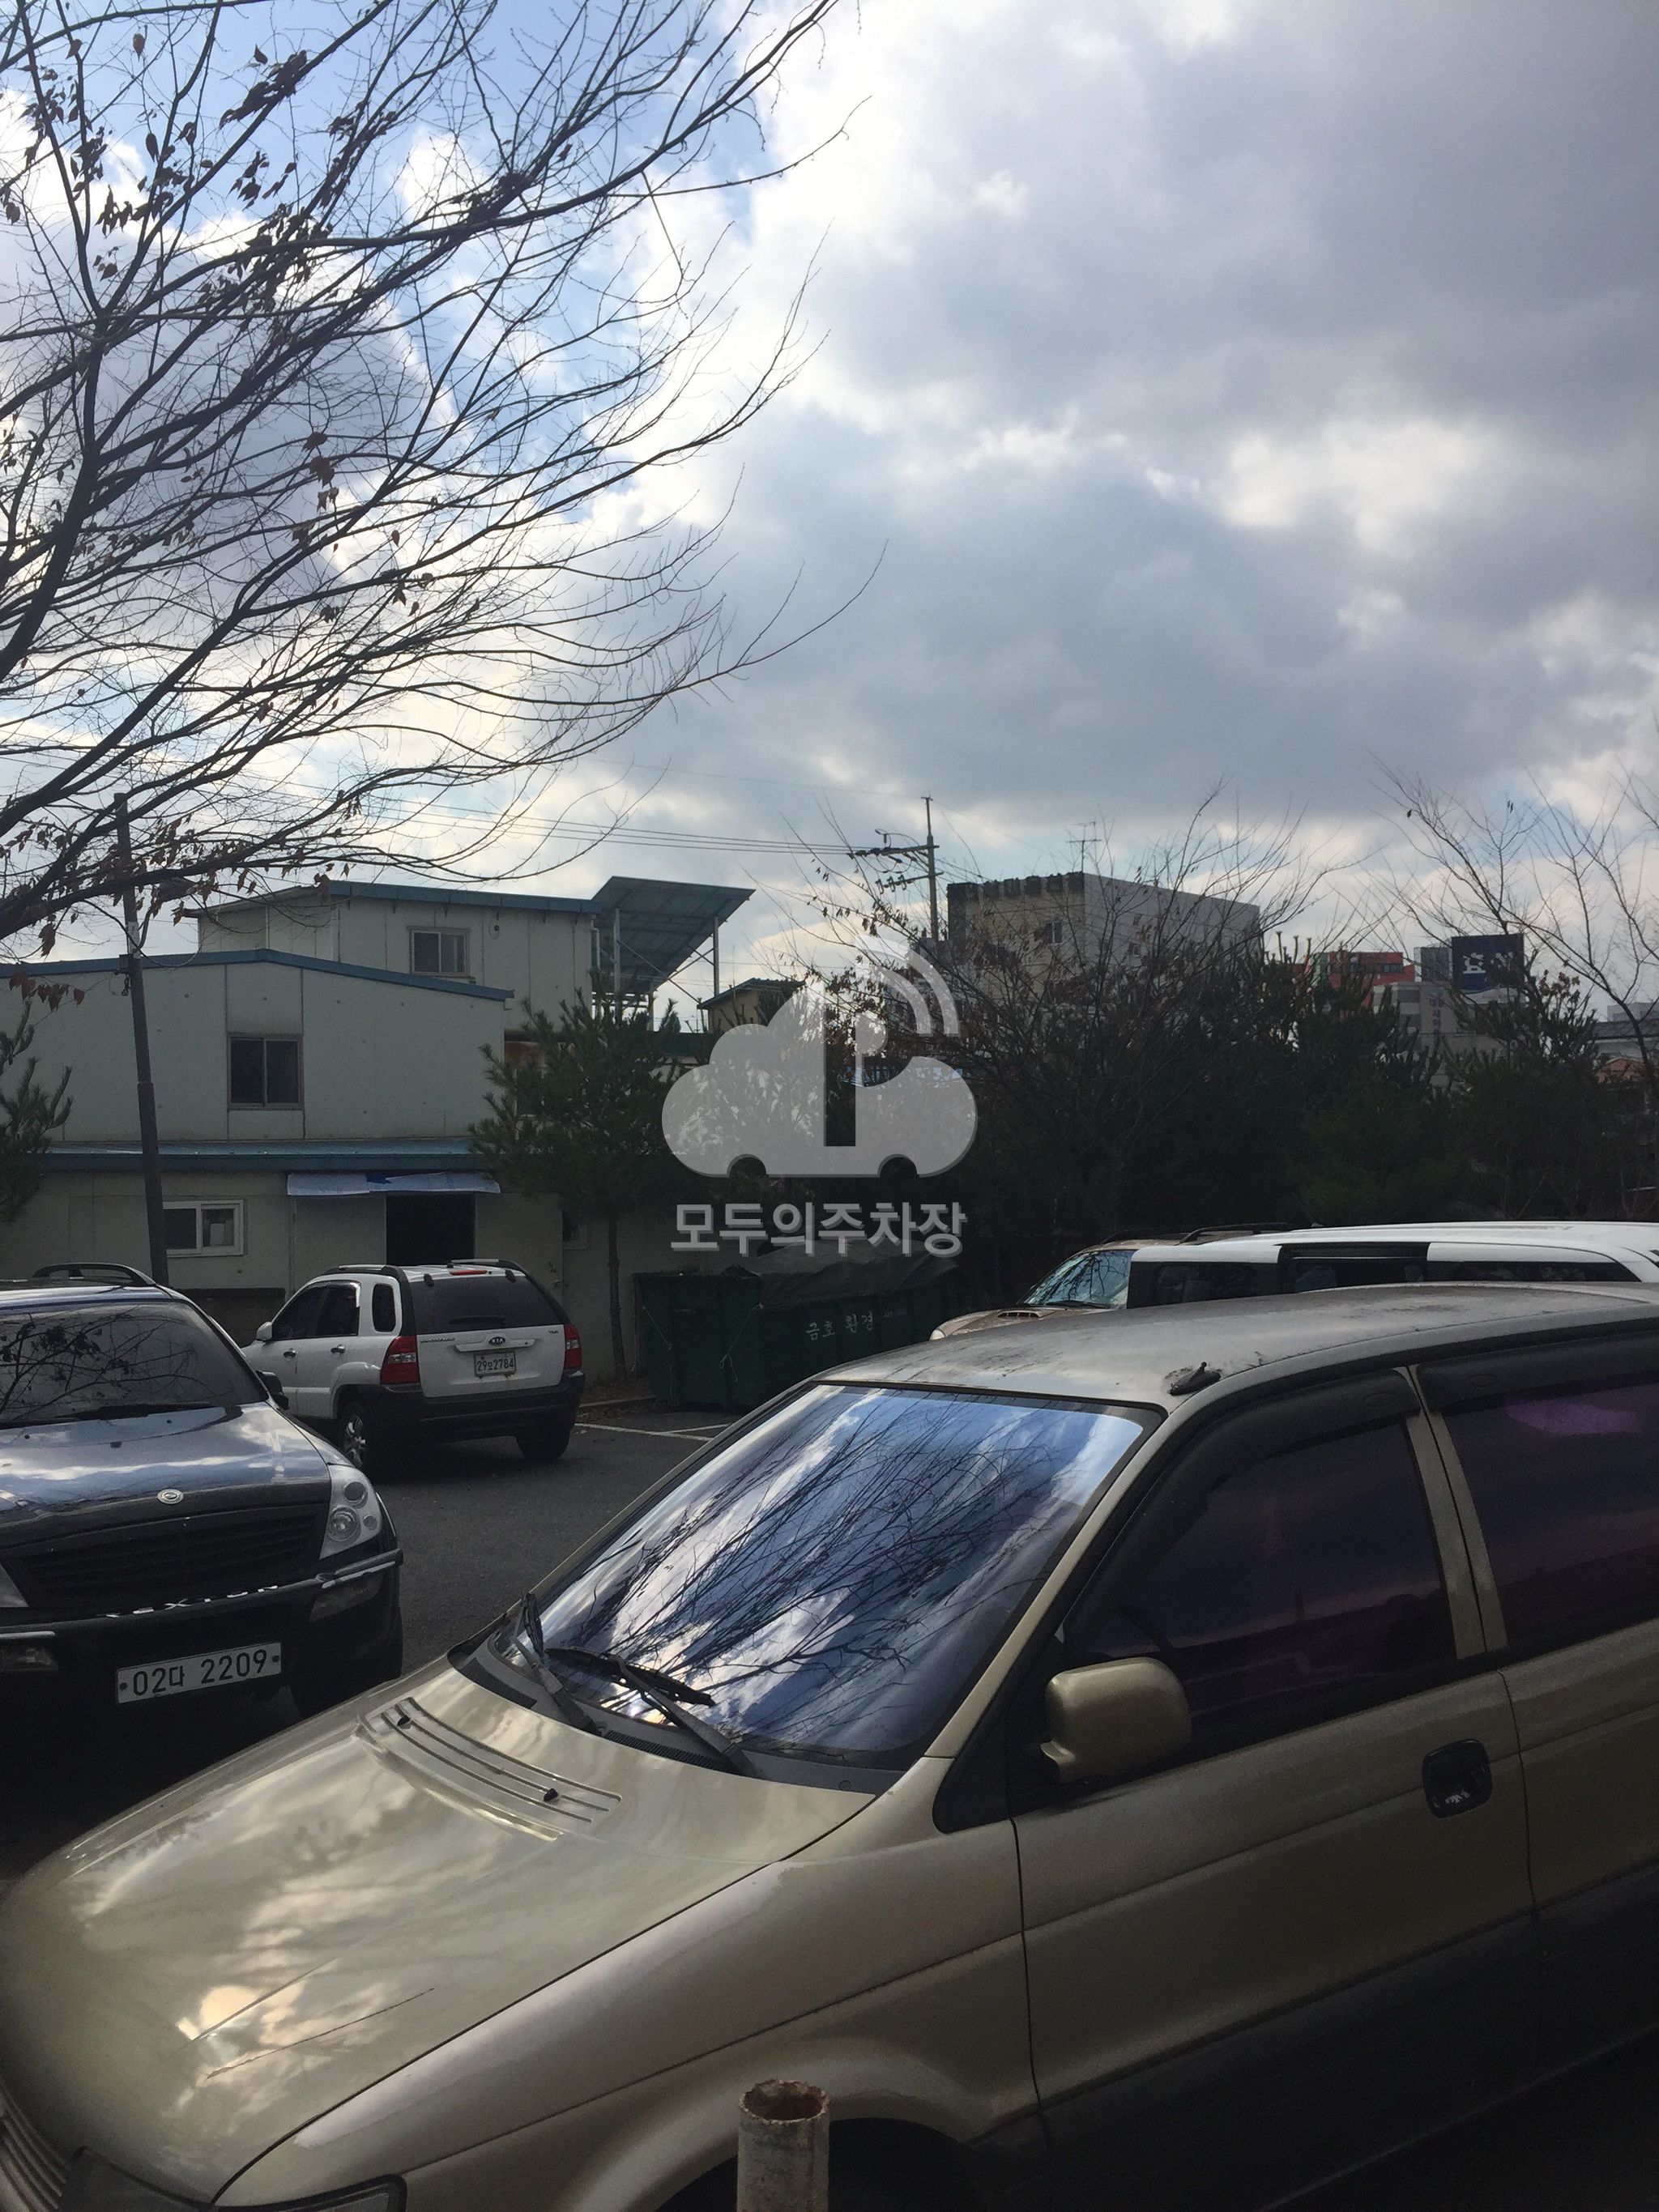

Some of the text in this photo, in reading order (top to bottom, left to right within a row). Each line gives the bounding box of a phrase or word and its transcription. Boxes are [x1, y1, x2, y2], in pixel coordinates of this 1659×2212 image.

[805, 1319, 836, 1341] 금호
[133, 1649, 267, 1696] 02다 2209
